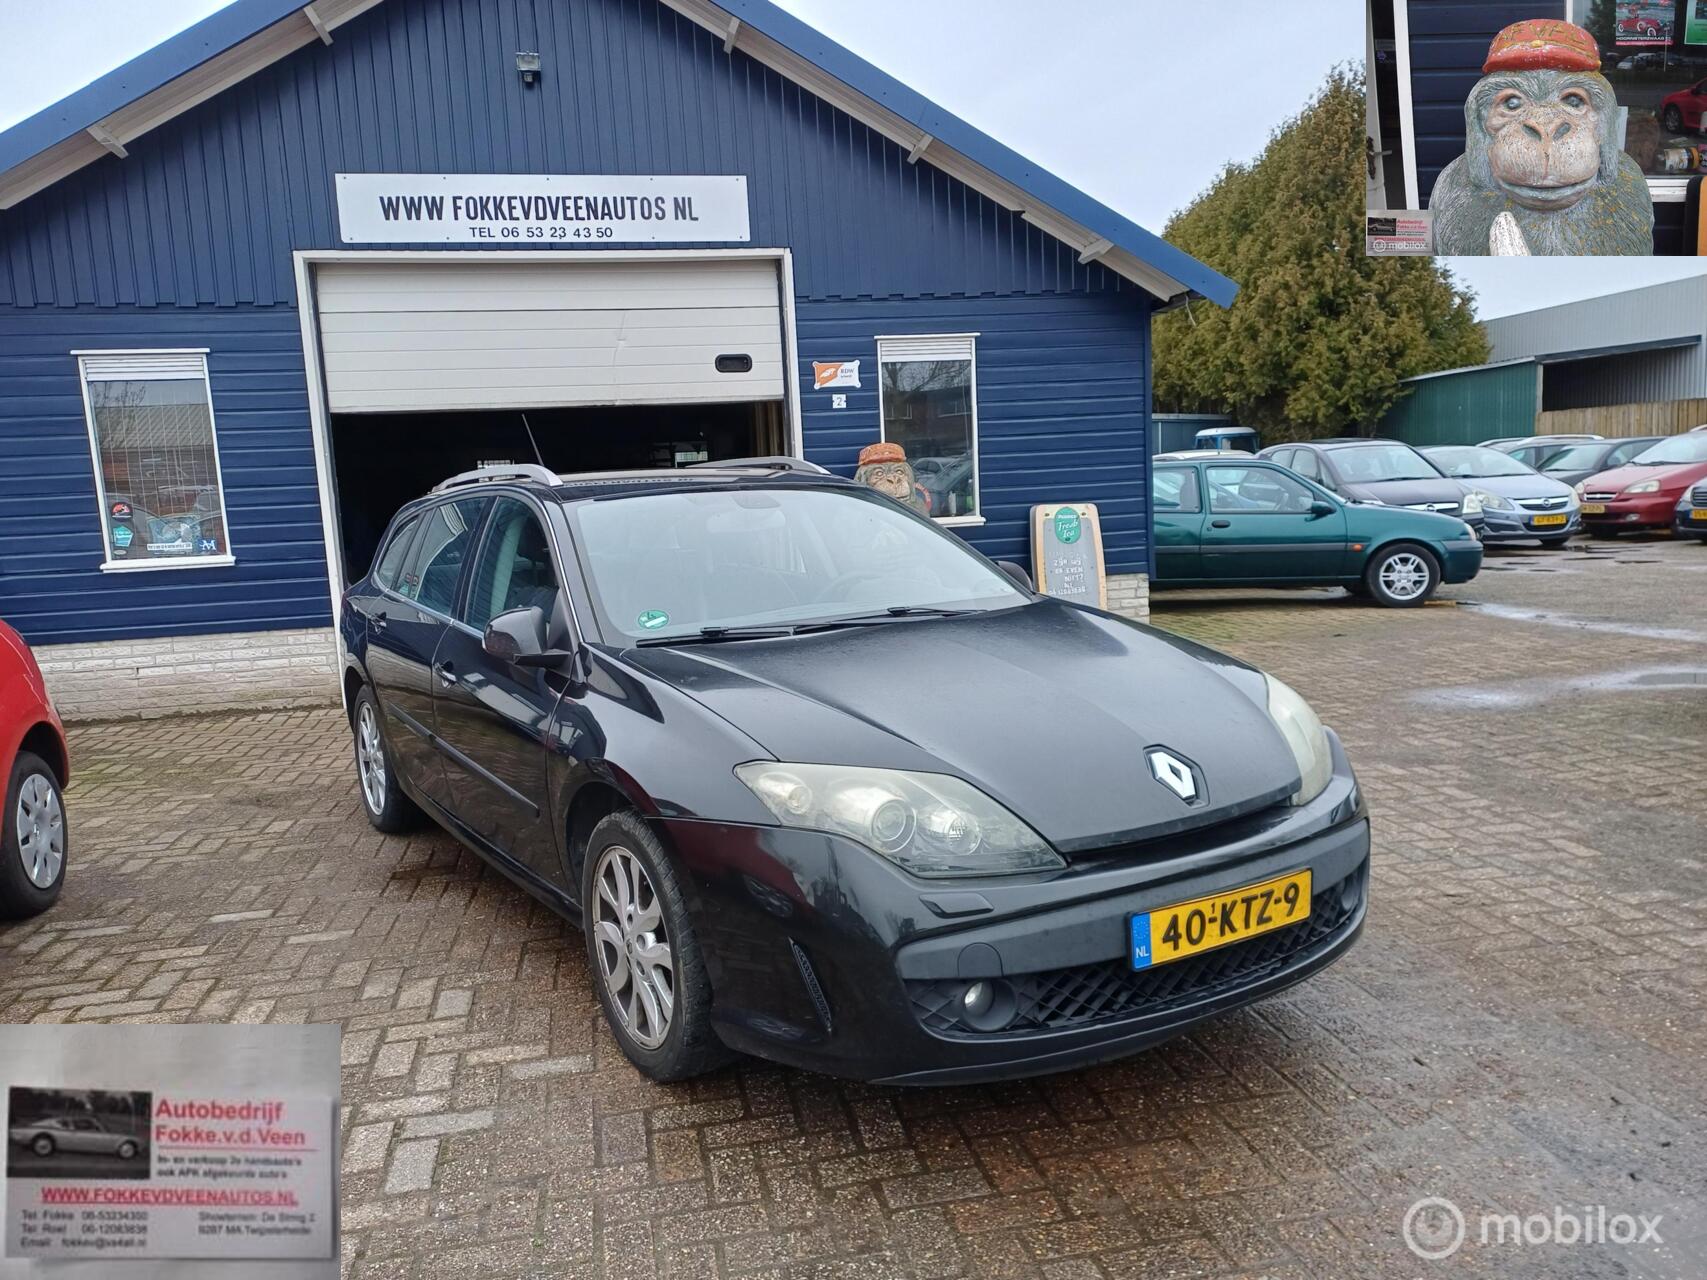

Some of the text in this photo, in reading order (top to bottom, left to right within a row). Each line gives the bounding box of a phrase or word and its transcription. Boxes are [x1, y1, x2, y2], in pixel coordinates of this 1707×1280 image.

[379, 195, 699, 221] WWW FOKKEVDVEENAUTOS NL
[469, 227, 613, 238] TEL 06 53 23 43 50
[1162, 881, 1300, 951] 40-KTZ-9
[1135, 945, 1150, 959] NL
